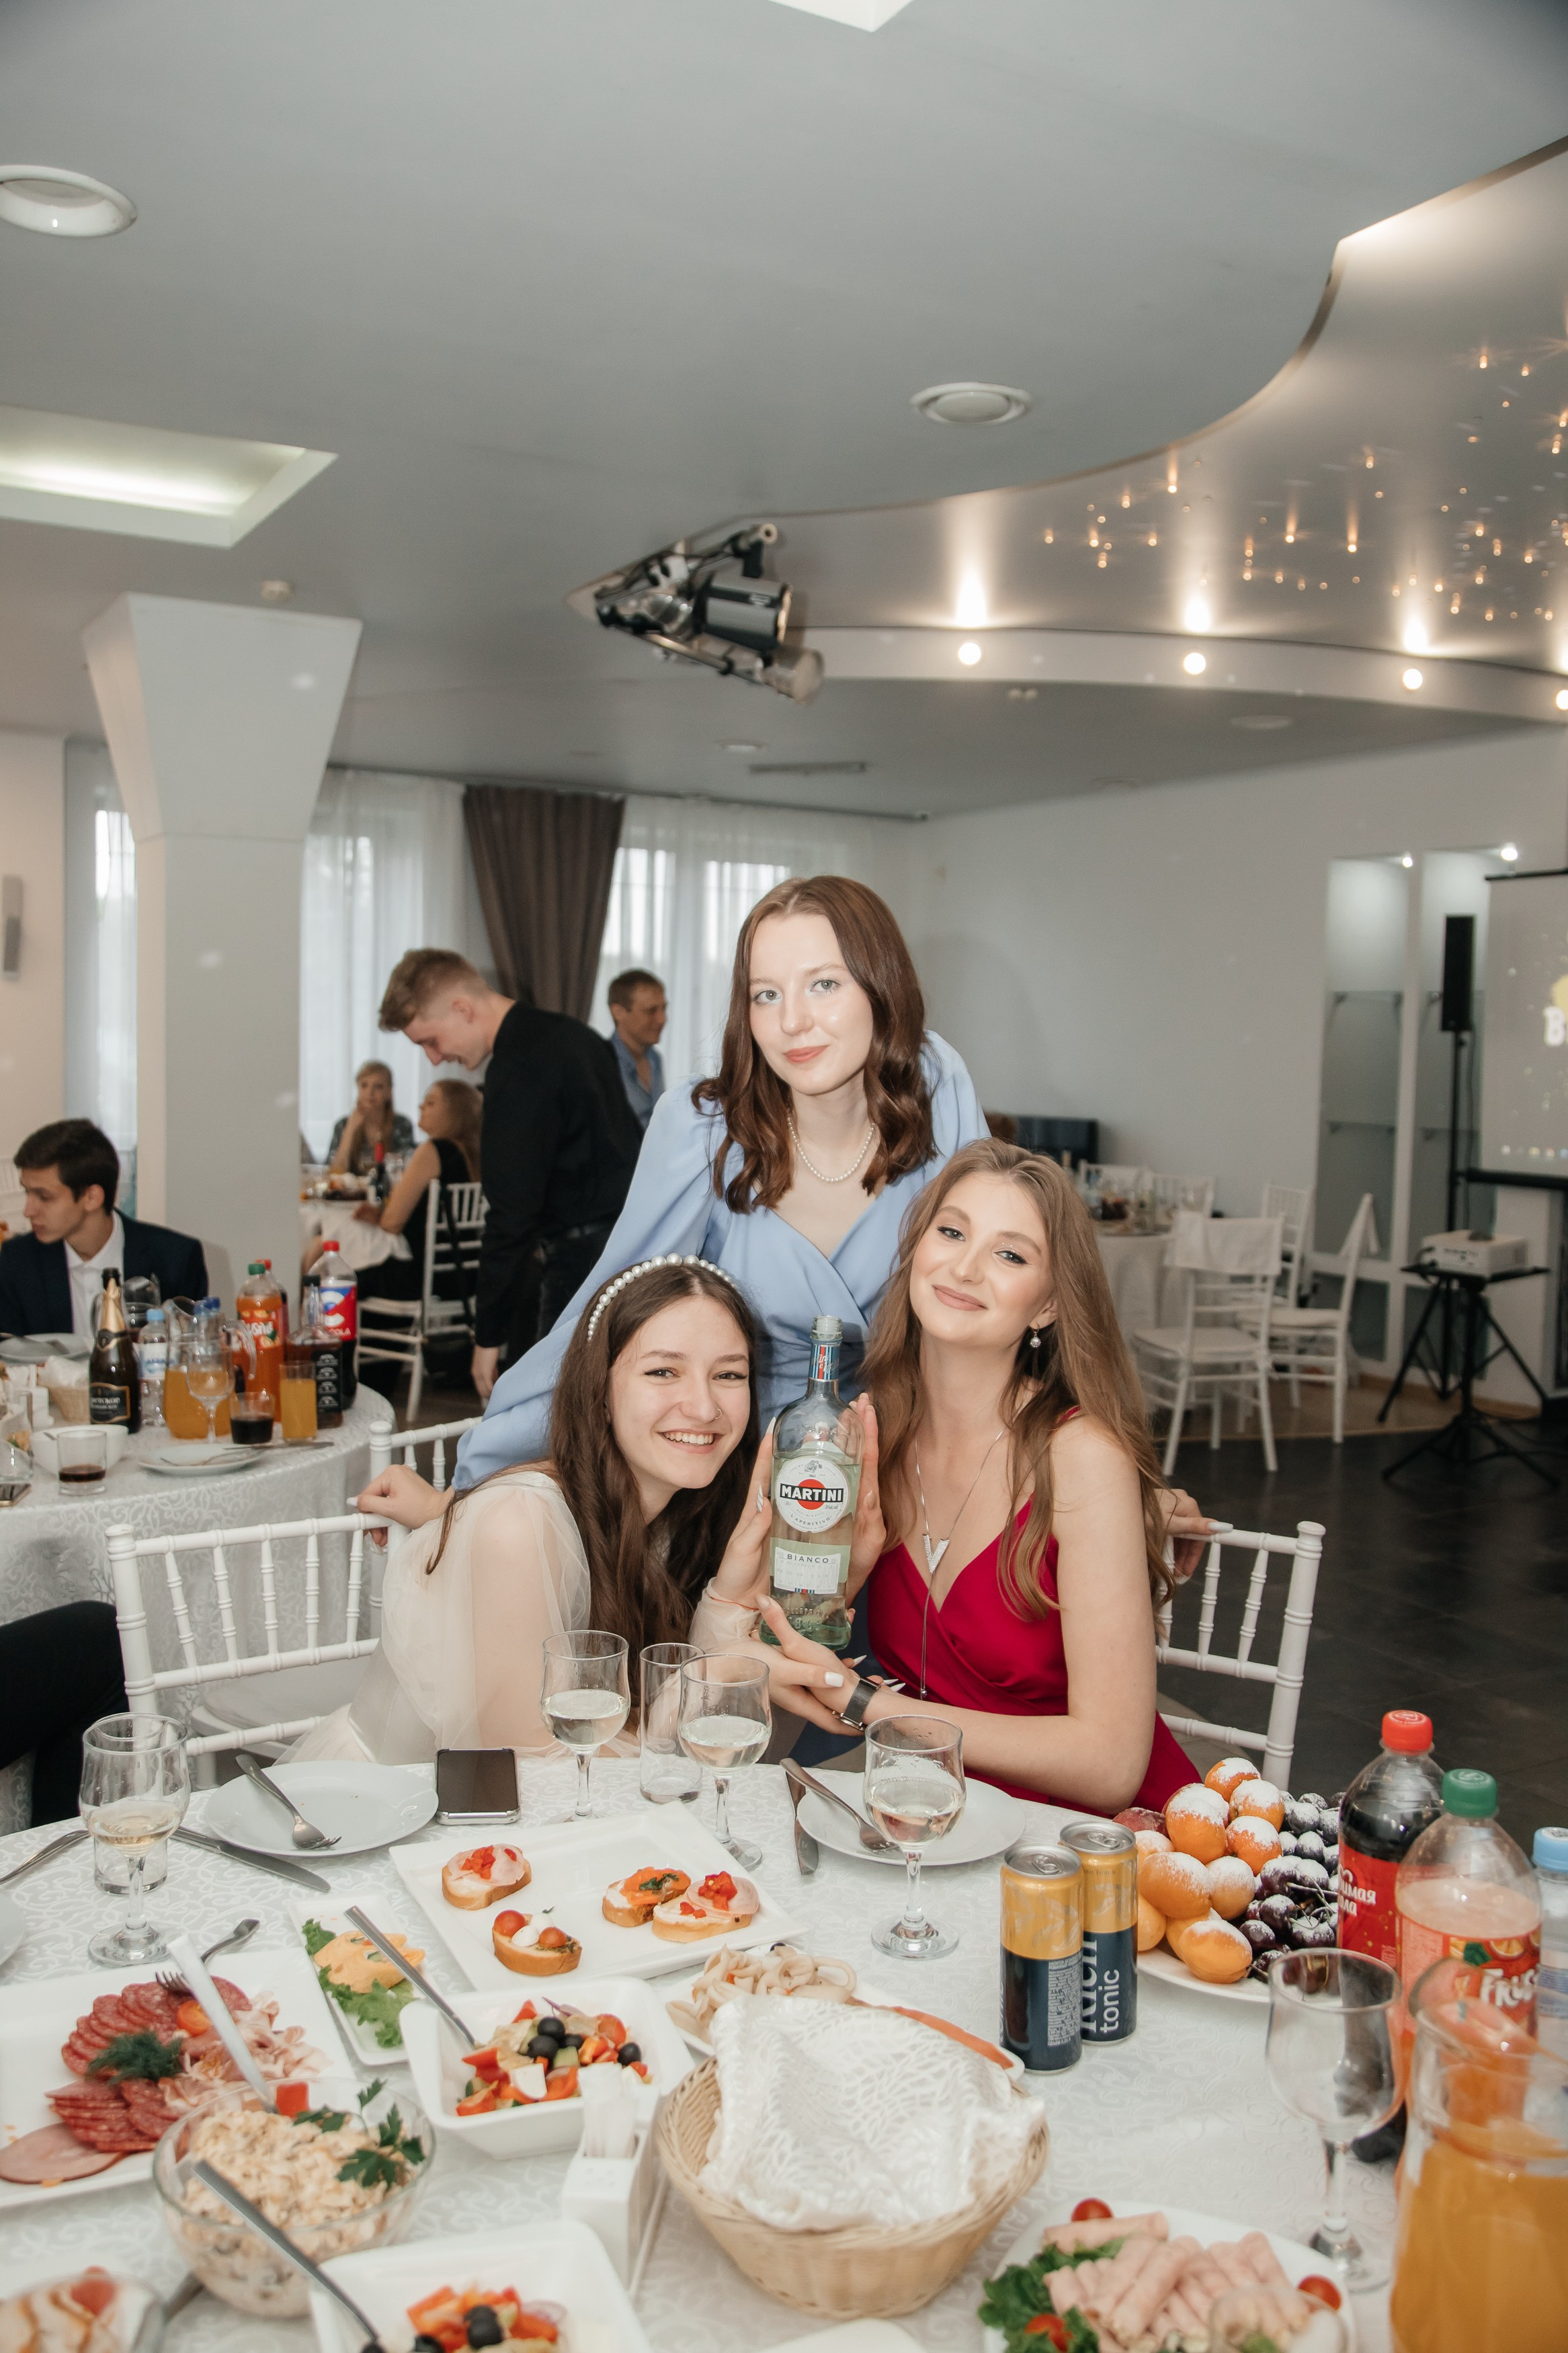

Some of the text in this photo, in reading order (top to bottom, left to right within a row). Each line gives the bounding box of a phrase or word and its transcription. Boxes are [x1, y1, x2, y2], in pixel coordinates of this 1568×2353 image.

[781, 1484, 842, 1502] MARTINI
[787, 1554, 829, 1564] BIANCO
[1098, 1969, 1120, 2033] tonic
